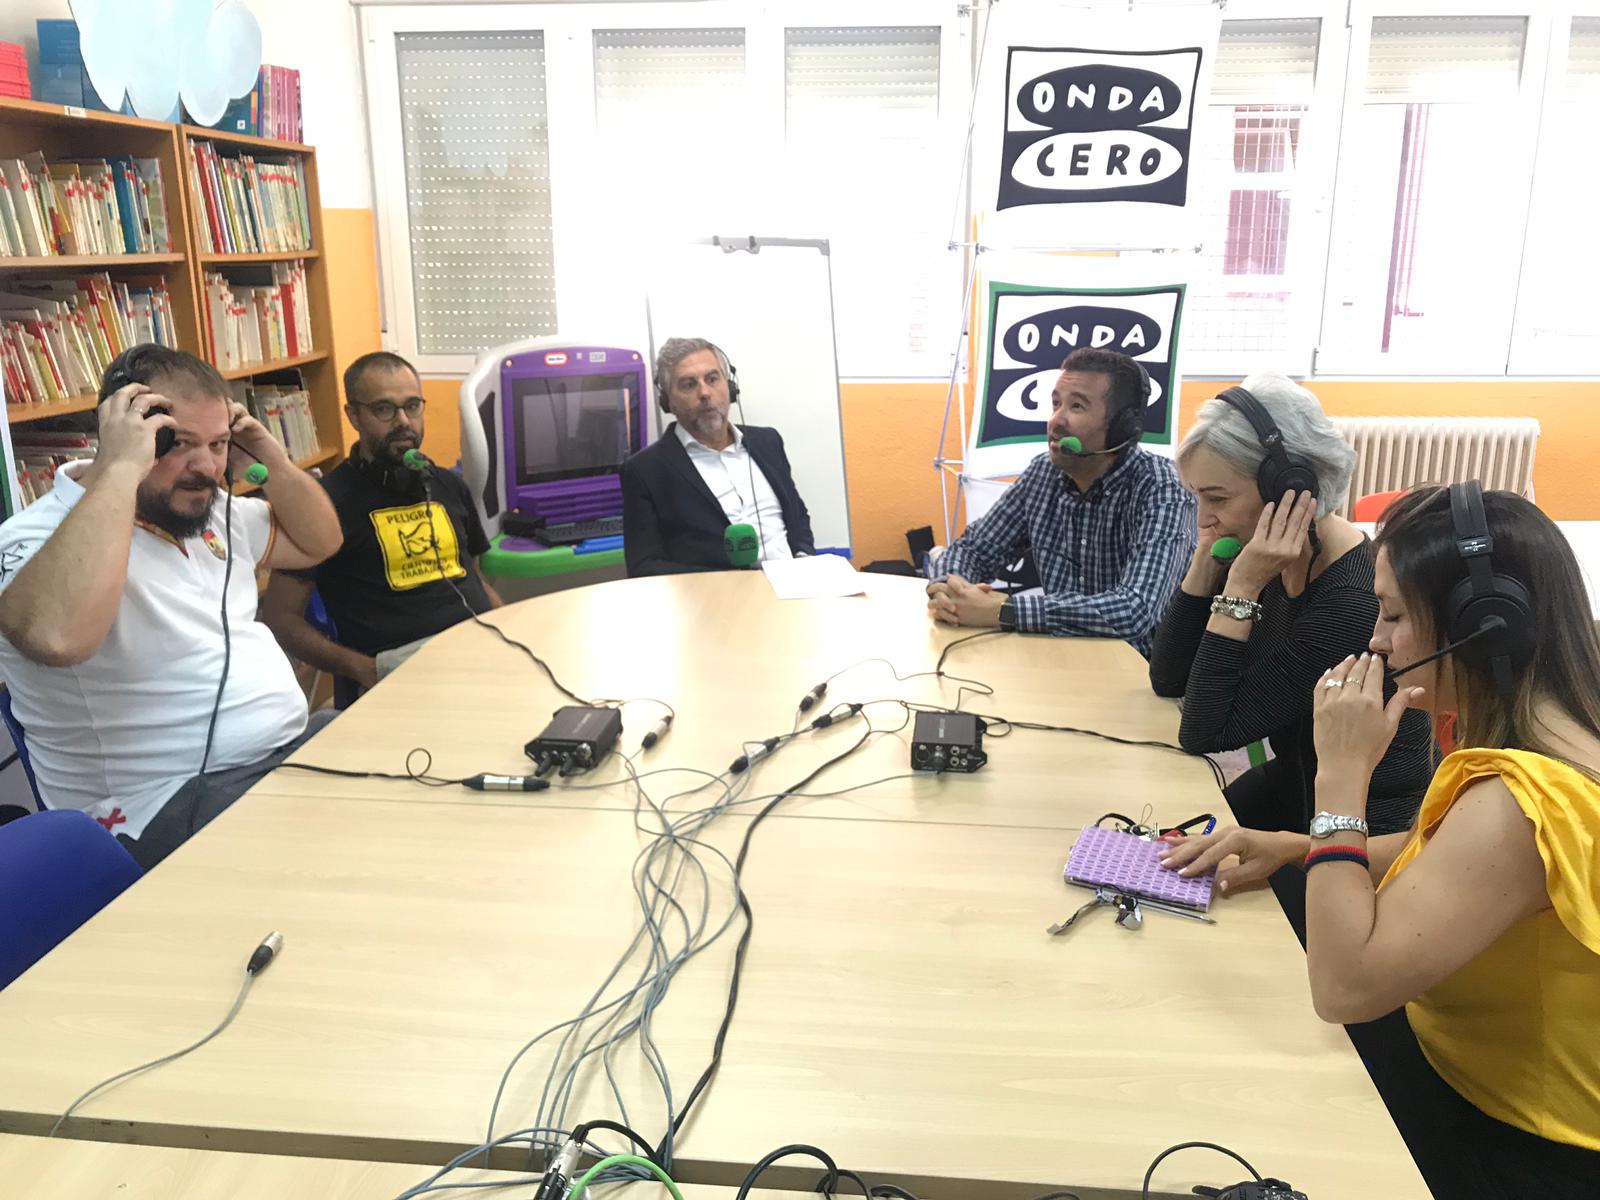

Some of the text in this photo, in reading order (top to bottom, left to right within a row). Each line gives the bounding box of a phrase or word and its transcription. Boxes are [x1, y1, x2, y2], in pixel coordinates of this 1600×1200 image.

[1031, 81, 1166, 114] ONDA
[1036, 142, 1162, 177] CERO
[1016, 322, 1147, 353] ONDA
[386, 510, 432, 524] PELIGR
